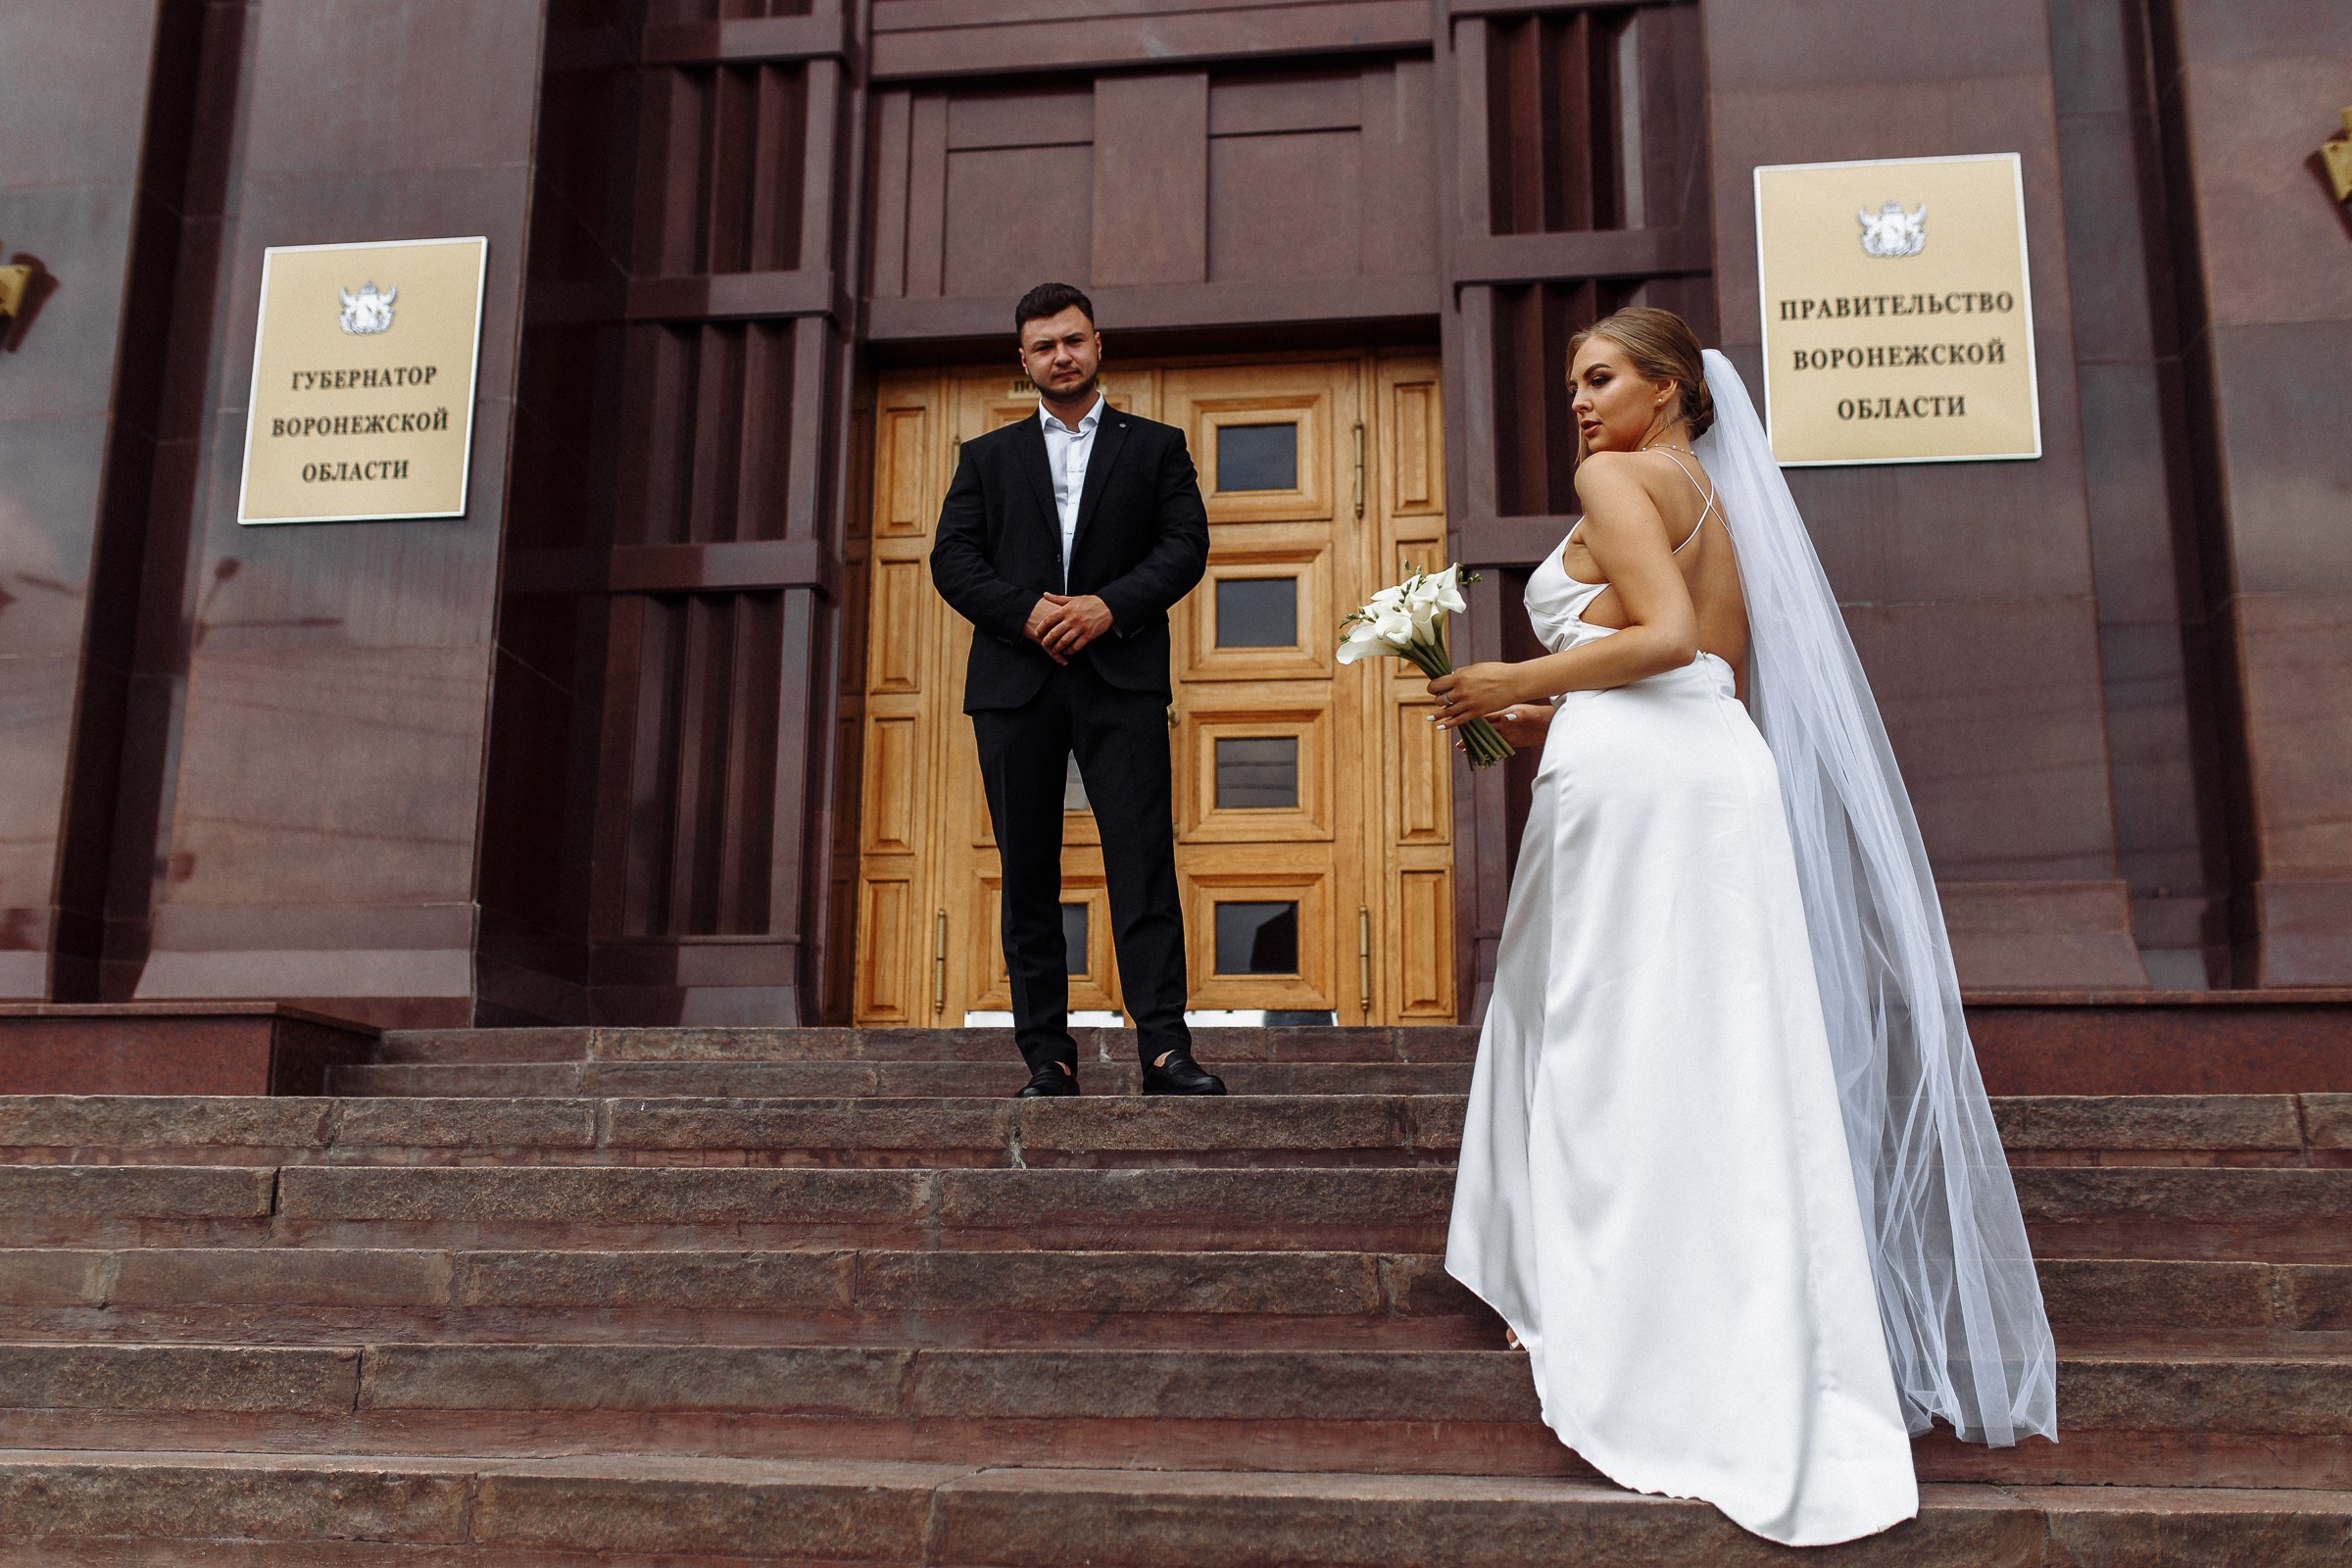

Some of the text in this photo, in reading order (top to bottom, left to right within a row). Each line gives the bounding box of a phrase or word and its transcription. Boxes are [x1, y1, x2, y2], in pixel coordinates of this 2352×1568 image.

[1780, 291, 2014, 321] ПРАВИТЕЛЬСТВО
[1792, 337, 2006, 370] ВОРОНЕЖСКОЙ
[291, 366, 438, 390] ГУБЕРНАТОР
[1837, 395, 1966, 420] ОБЛАСТИ
[271, 406, 450, 437] ВОРОНЕЖСКОЙ
[301, 459, 410, 483] ОБЛАСТИ
